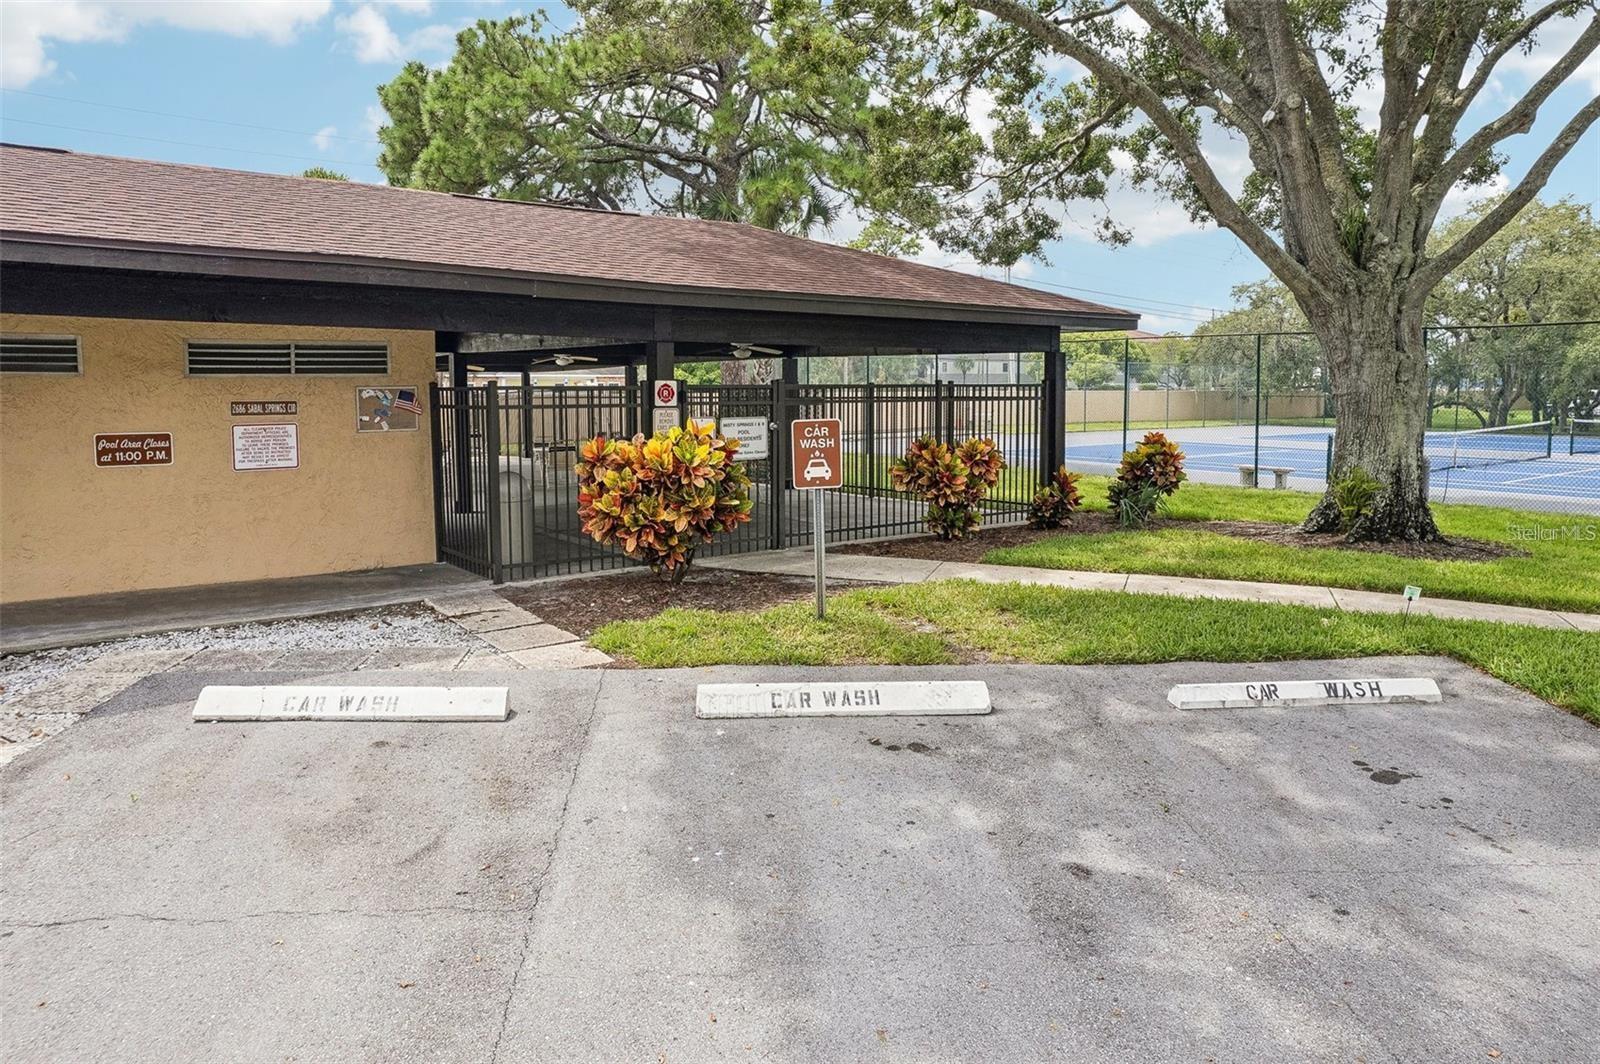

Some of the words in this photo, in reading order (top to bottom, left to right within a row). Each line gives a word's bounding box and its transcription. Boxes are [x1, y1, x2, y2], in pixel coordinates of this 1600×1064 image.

[232, 404, 246, 414] 2686
[248, 404, 264, 413] SABAL
[264, 403, 286, 412] SPRINGS
[804, 426, 829, 438] CAR
[98, 439, 119, 450] Pool
[120, 438, 142, 448] Area
[143, 438, 170, 450] Closes
[800, 438, 834, 448] WASH
[101, 453, 112, 462] at
[115, 451, 142, 461] 11:00
[146, 451, 168, 460] P.M.
[1246, 684, 1280, 700] CAR
[1322, 681, 1383, 700] WASH
[282, 696, 326, 712] CAR
[340, 695, 398, 712] WASH
[771, 692, 811, 709] CAR
[822, 689, 880, 708] WASH
